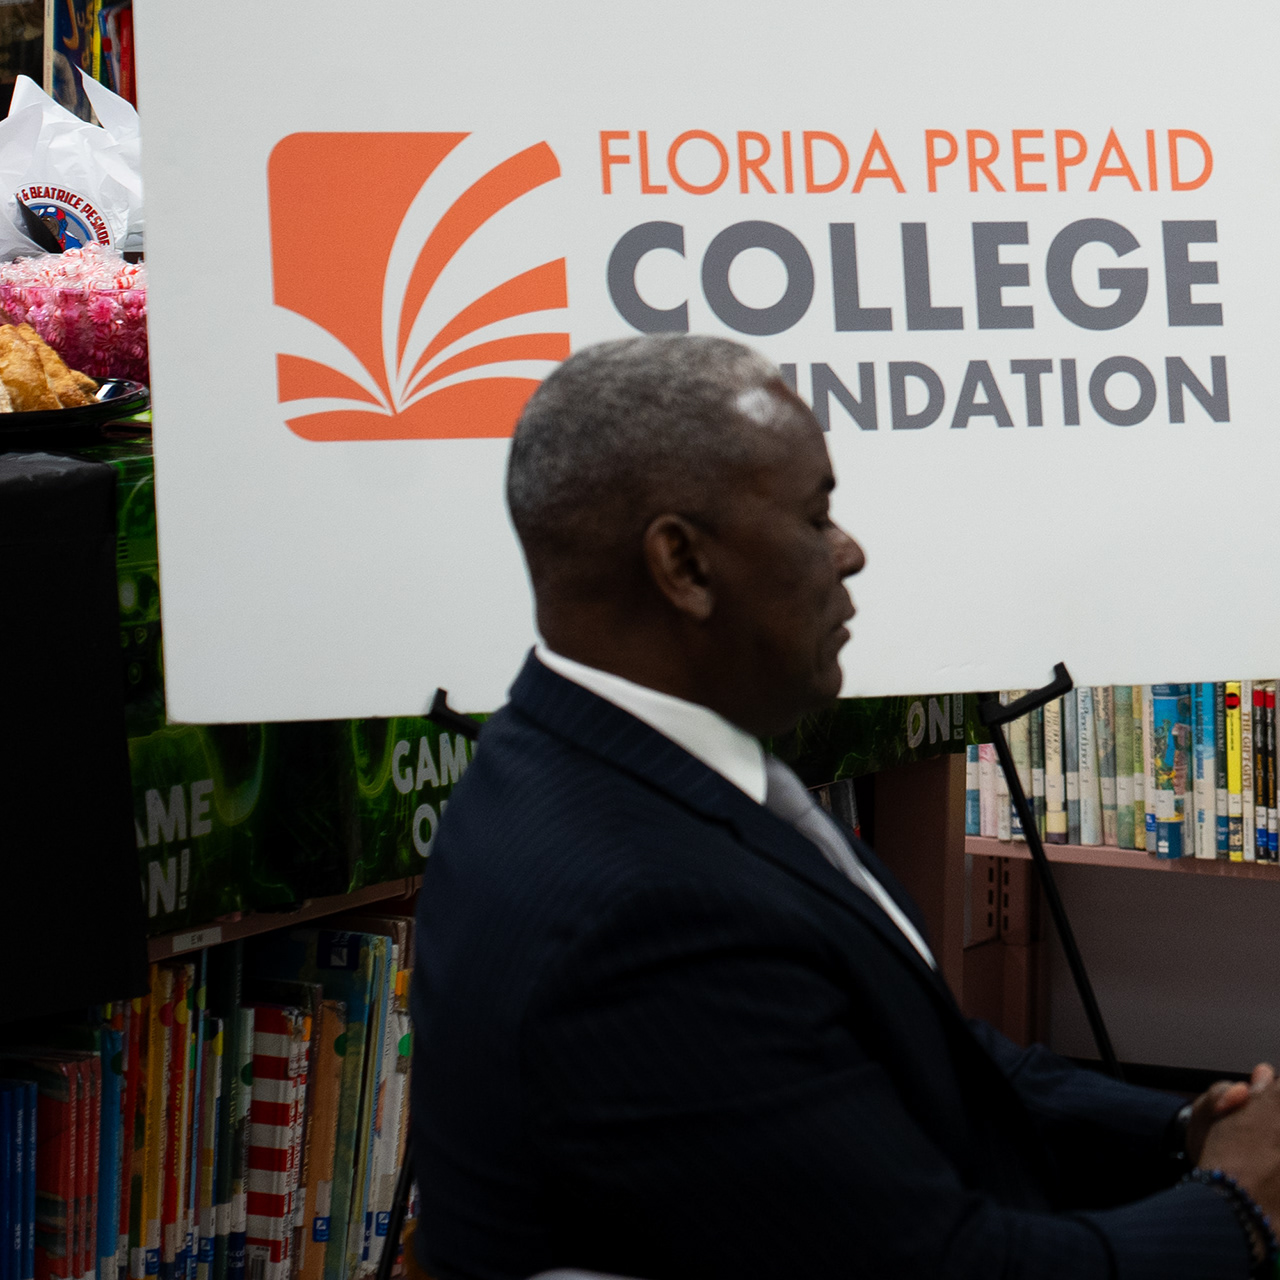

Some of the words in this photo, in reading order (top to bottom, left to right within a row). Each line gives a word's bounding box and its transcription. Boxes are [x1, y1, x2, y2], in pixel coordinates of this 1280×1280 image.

[599, 128, 907, 196] FLORIDA
[924, 126, 1214, 192] PREPAID
[21, 189, 30, 202] &
[29, 186, 84, 210] BEATRICE
[606, 216, 1224, 337] COLLEGE
[780, 354, 1231, 432] NDATION
[905, 694, 964, 749] ON!
[1079, 689, 1089, 708] The
[1080, 708, 1088, 732] Planet
[1242, 711, 1251, 734] THE
[392, 734, 479, 795] GAM
